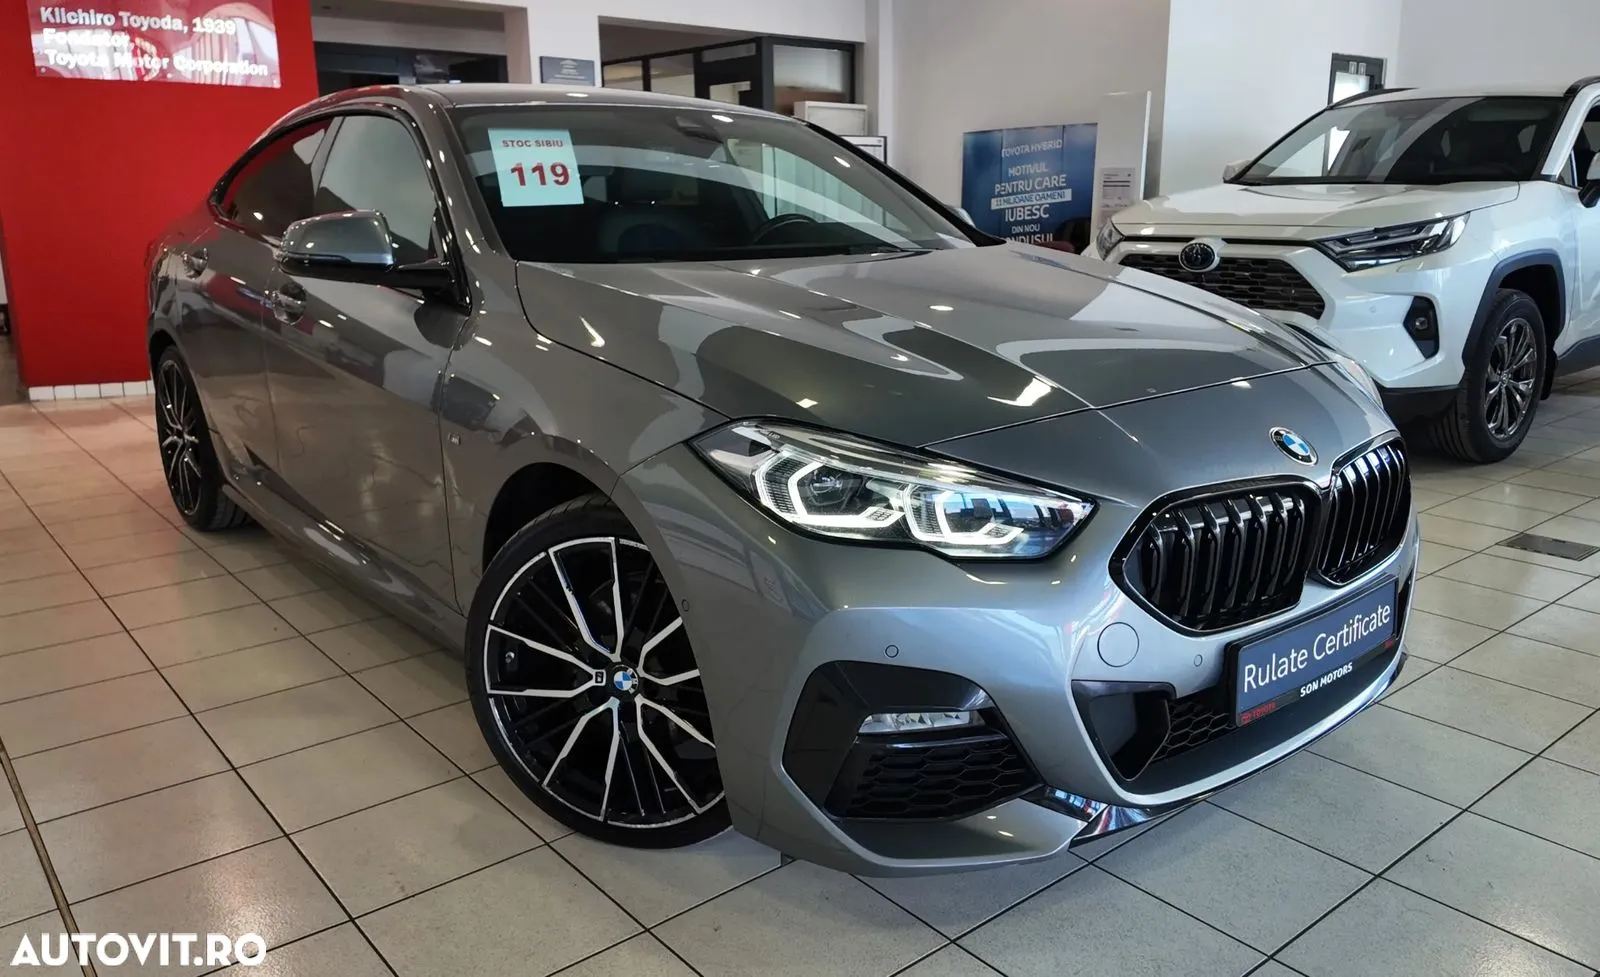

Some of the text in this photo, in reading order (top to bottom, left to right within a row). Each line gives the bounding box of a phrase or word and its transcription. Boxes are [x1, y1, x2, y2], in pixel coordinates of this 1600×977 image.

[118, 11, 188, 34] Toyoda,
[192, 17, 236, 35] 1939
[44, 49, 268, 76] Toyota Motor Corporation
[502, 140, 564, 148] STOC SIBIU
[1001, 139, 1063, 157] TOYOTA HYBRID
[510, 162, 570, 187] 119
[1008, 162, 1048, 177] MOTIVUL
[995, 174, 1068, 195] PENTRU CARE
[1005, 204, 1050, 222] IUBESC
[1011, 223, 1041, 234] DIN NOU
[1243, 604, 1391, 693] Rulate Certificate
[1300, 662, 1353, 698] SON MOTORS
